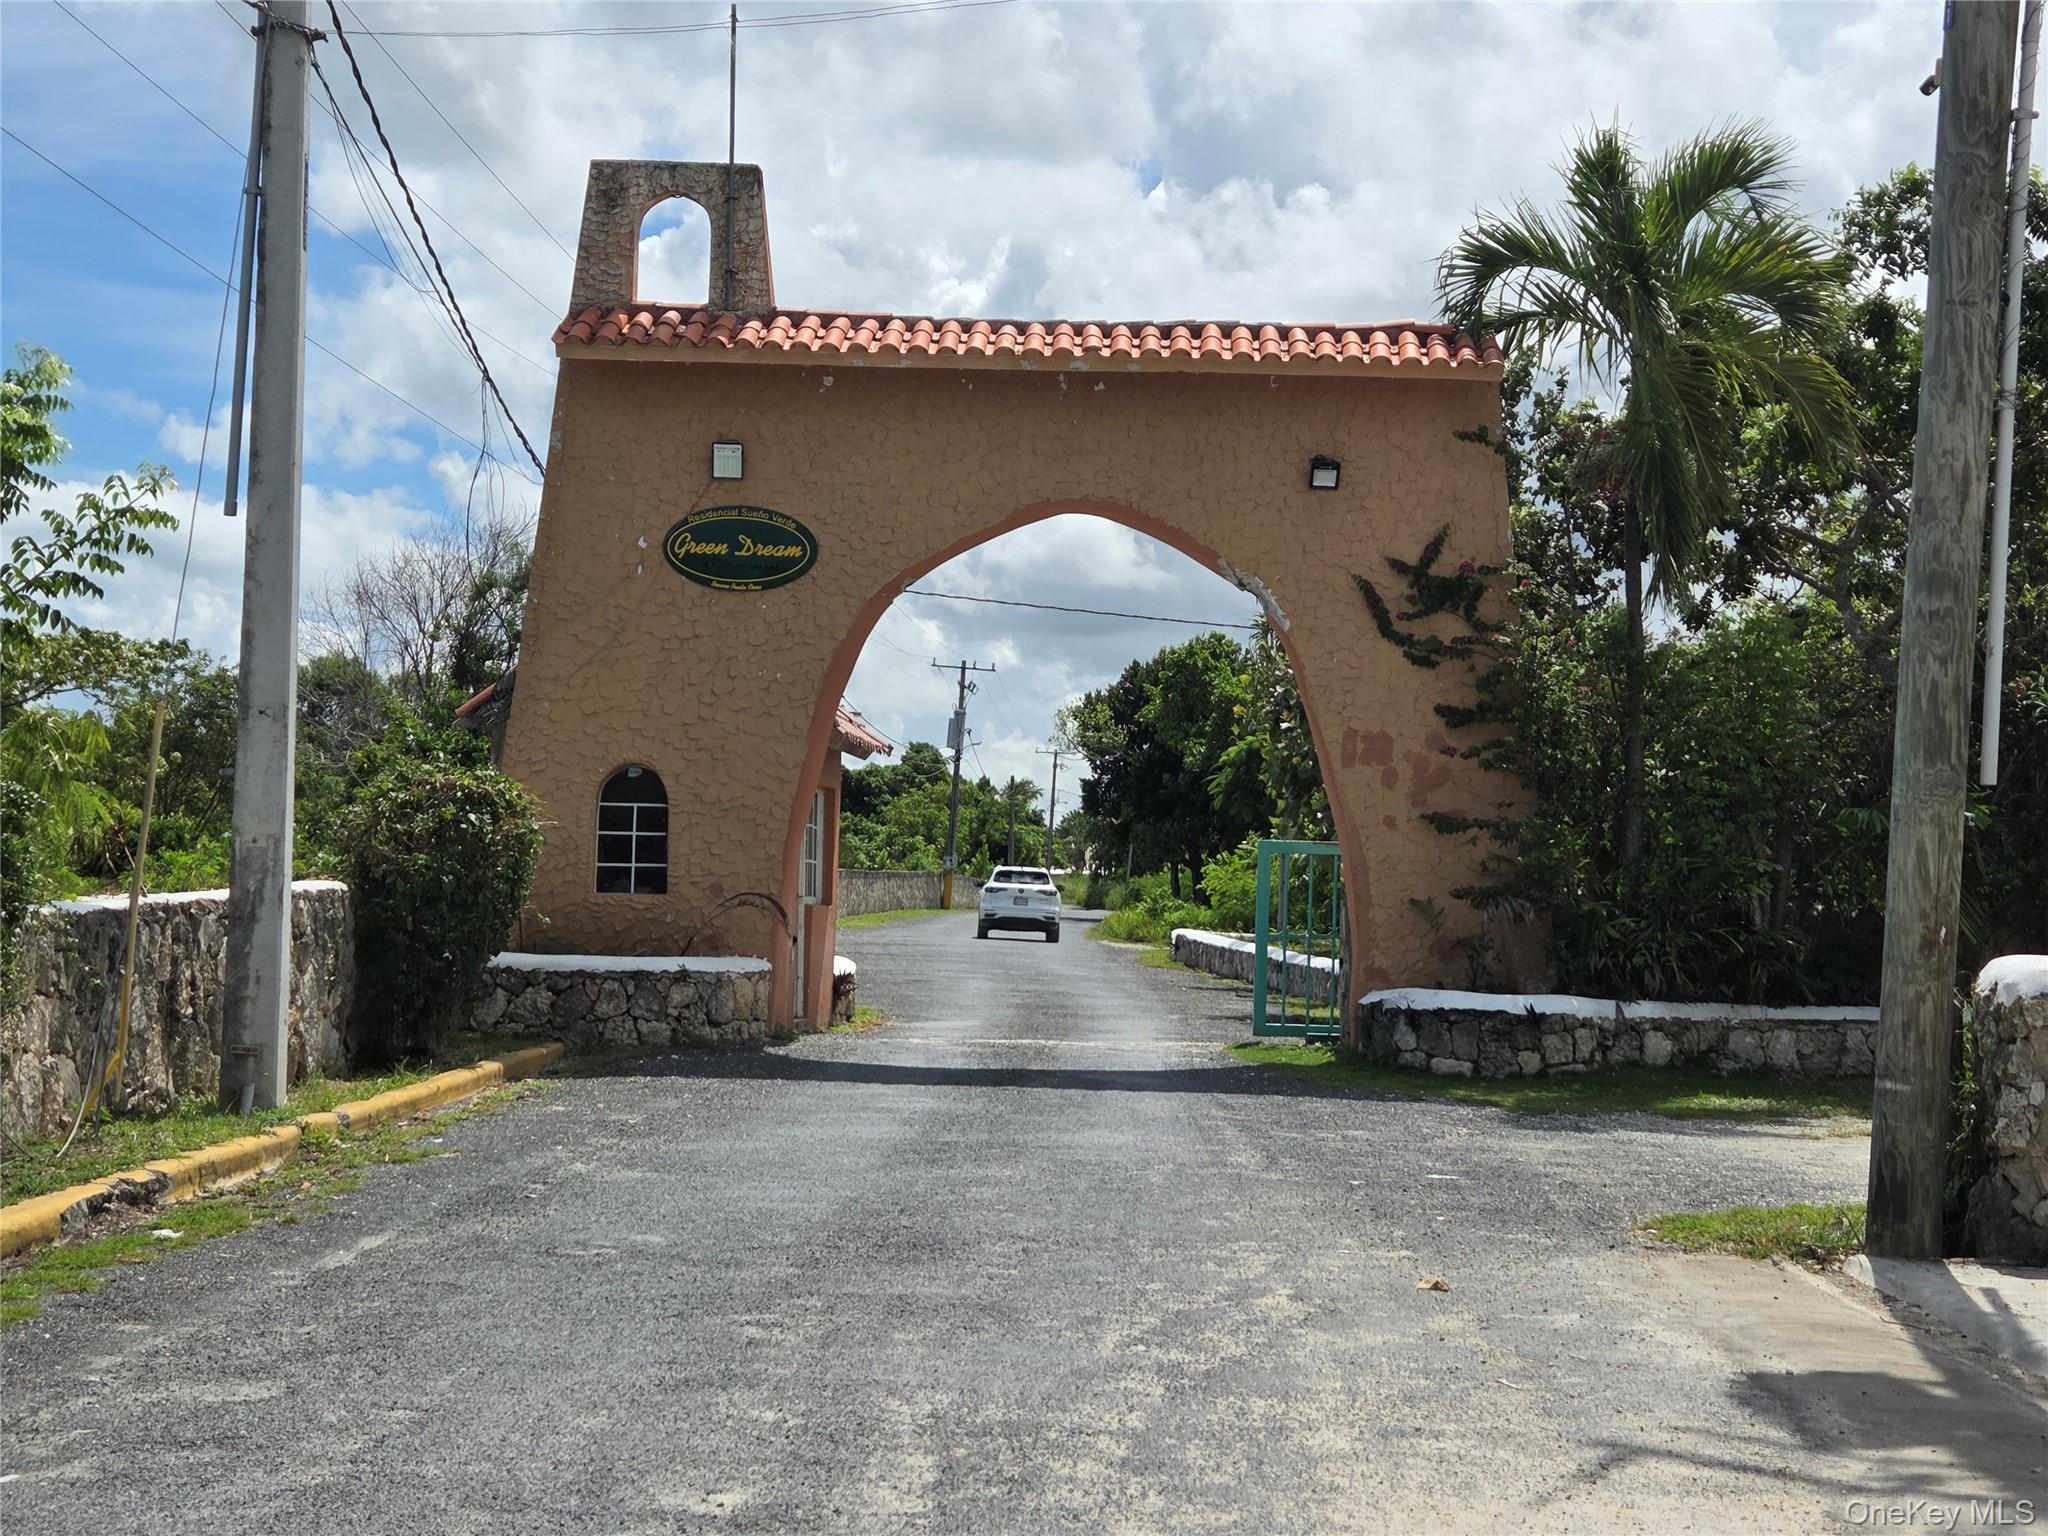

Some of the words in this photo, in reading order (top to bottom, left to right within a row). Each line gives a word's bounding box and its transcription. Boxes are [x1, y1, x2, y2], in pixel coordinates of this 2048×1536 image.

[687, 508, 739, 524] Residencial
[741, 508, 770, 520] Sueño
[772, 513, 797, 529] Verde
[674, 532, 729, 559] Green
[734, 534, 803, 558] Dream
